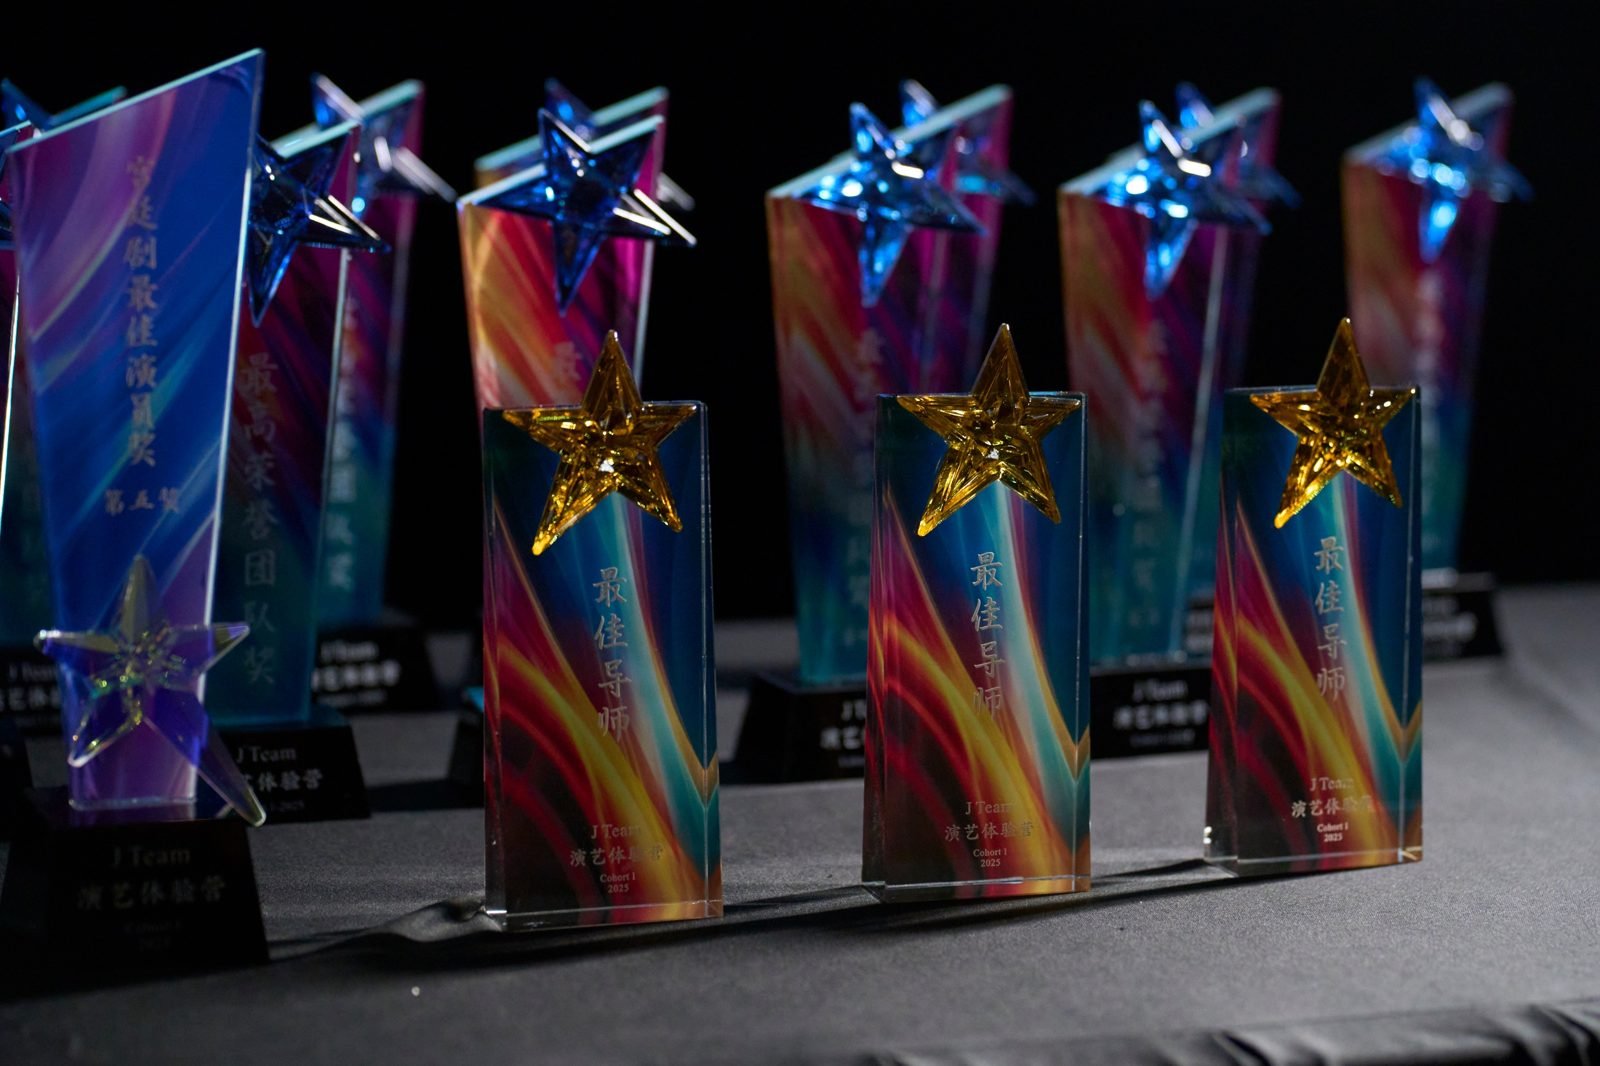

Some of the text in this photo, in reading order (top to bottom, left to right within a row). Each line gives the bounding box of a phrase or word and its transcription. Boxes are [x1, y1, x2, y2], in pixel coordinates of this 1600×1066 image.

[1313, 536, 1347, 702] 最佳导师
[970, 551, 1006, 720] 最佳导师
[592, 566, 632, 743] 最佳导师
[1310, 778, 1317, 791] J
[965, 802, 973, 815] J
[591, 825, 600, 840] J
[1316, 823, 1343, 833] Cohort
[1324, 833, 1344, 843] 2025
[128, 844, 193, 869] Team
[973, 848, 1001, 858] Cohort
[980, 858, 1001, 868] 2025
[600, 873, 630, 884] Cohort
[607, 884, 630, 894] 2025
